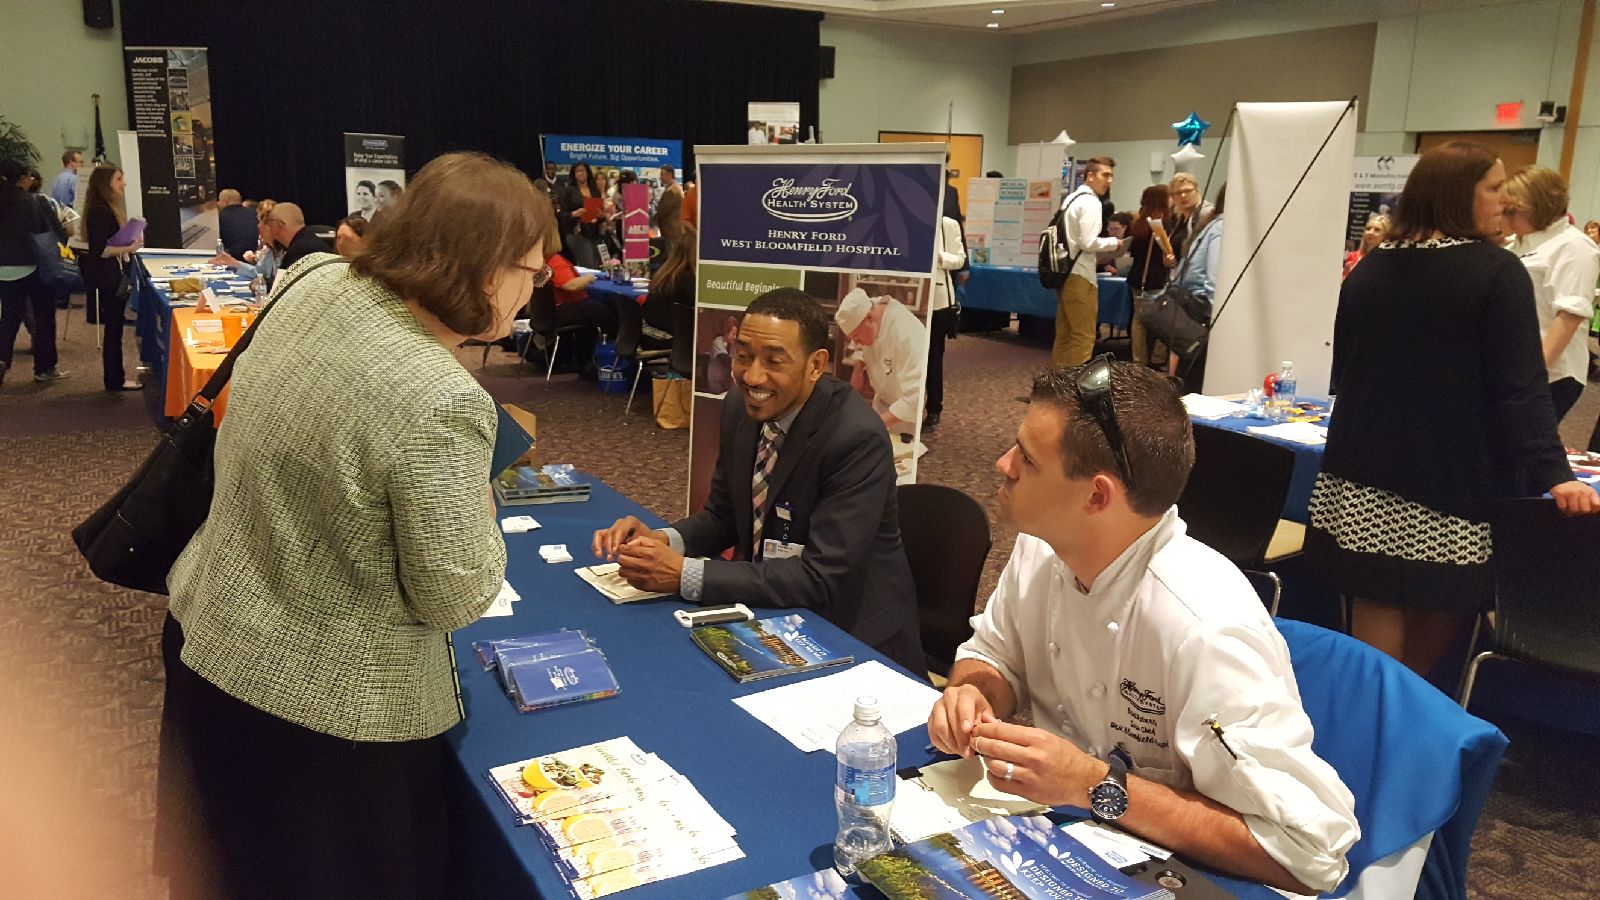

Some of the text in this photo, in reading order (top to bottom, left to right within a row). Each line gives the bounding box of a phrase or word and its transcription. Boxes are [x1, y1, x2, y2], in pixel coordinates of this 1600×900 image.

[133, 56, 164, 64] JACOBS
[560, 142, 668, 156] ENERGIZE YOUR CAREER
[569, 152, 587, 161] Bright
[610, 153, 620, 162] Big
[771, 177, 853, 202] Henry Ford
[767, 198, 854, 209] HEALTH SYSTEM
[767, 229, 847, 241] HENRY FORD
[720, 238, 901, 256] WEST BLOOMFIELD HOSPITAL
[706, 279, 784, 294] Beautiful Beginni
[1020, 868, 1045, 887] KEEP
[1065, 857, 1110, 888] DESIGNED
[1029, 865, 1074, 898] DESIGNED
